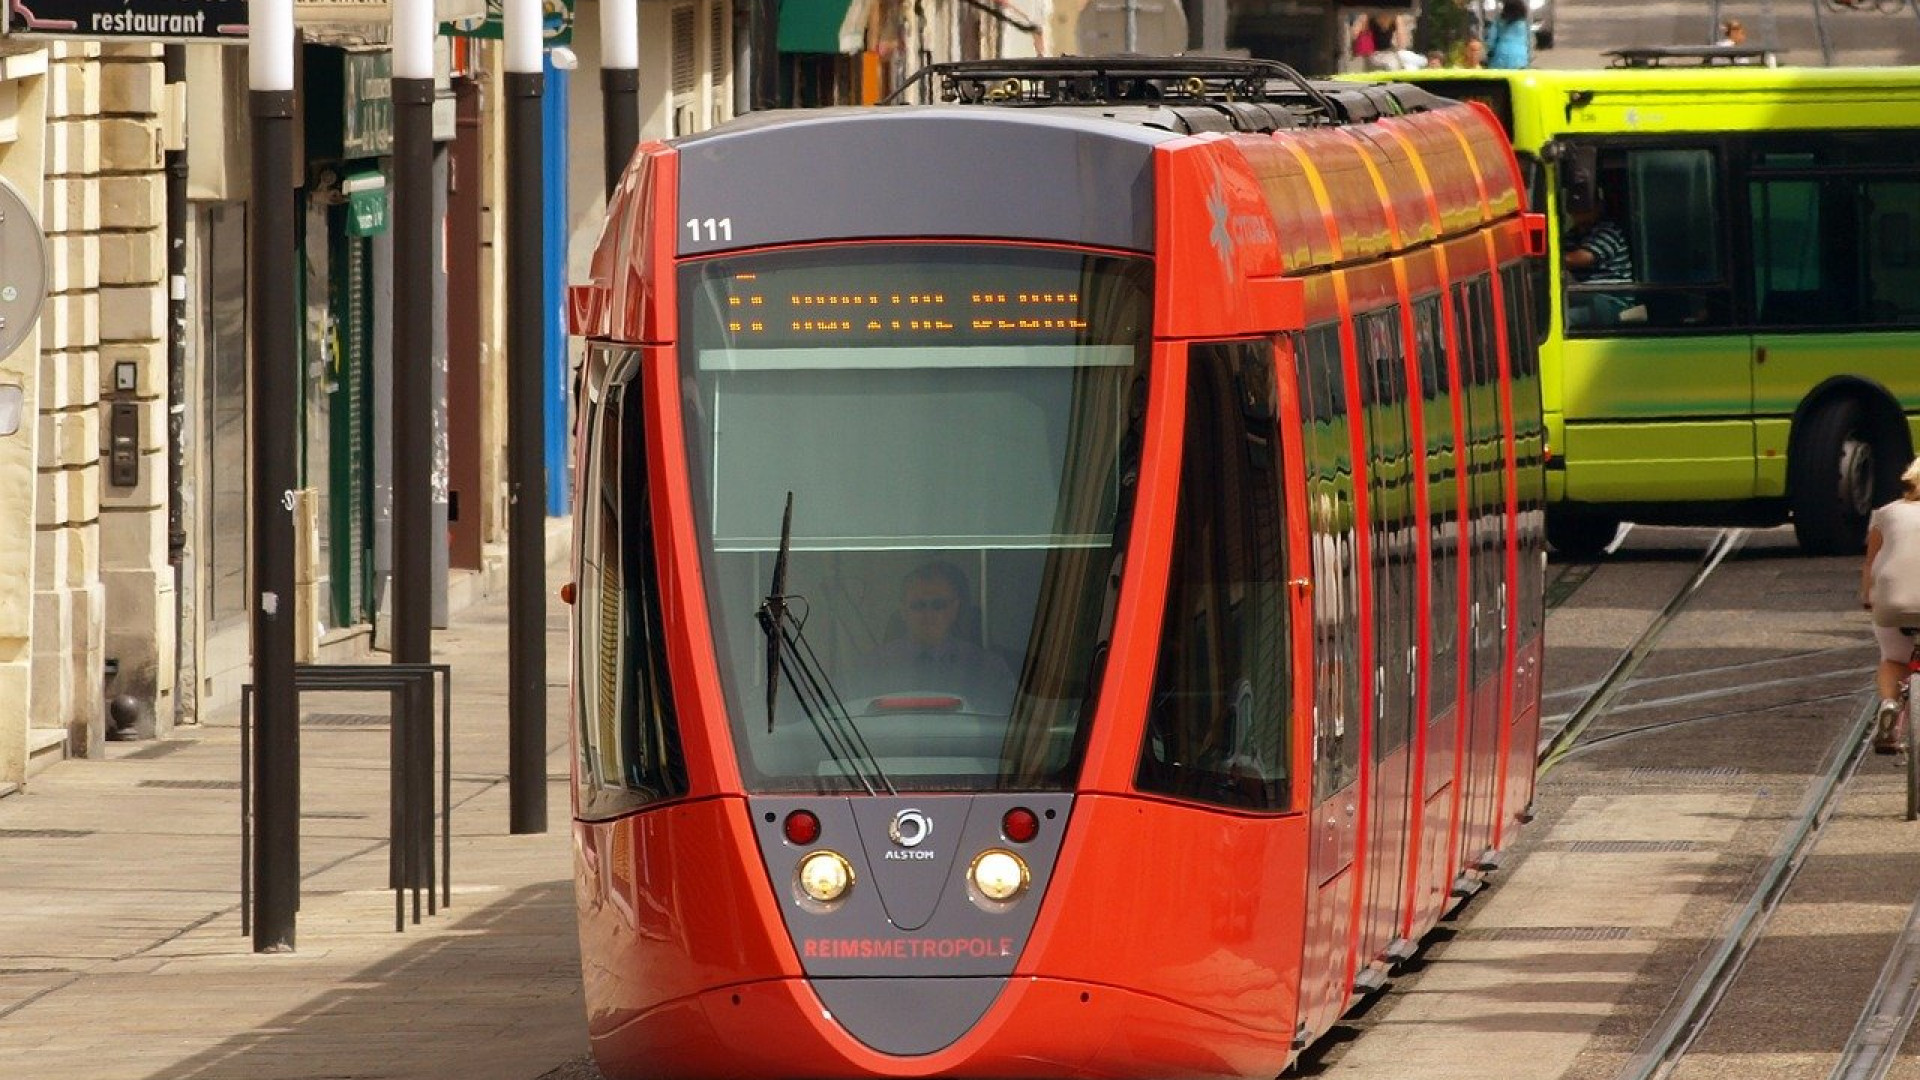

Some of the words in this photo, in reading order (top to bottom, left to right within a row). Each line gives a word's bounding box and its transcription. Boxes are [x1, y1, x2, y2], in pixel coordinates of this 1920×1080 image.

[92, 9, 205, 33] restaurant
[686, 218, 732, 241] 111
[884, 851, 934, 860] ALSTOM
